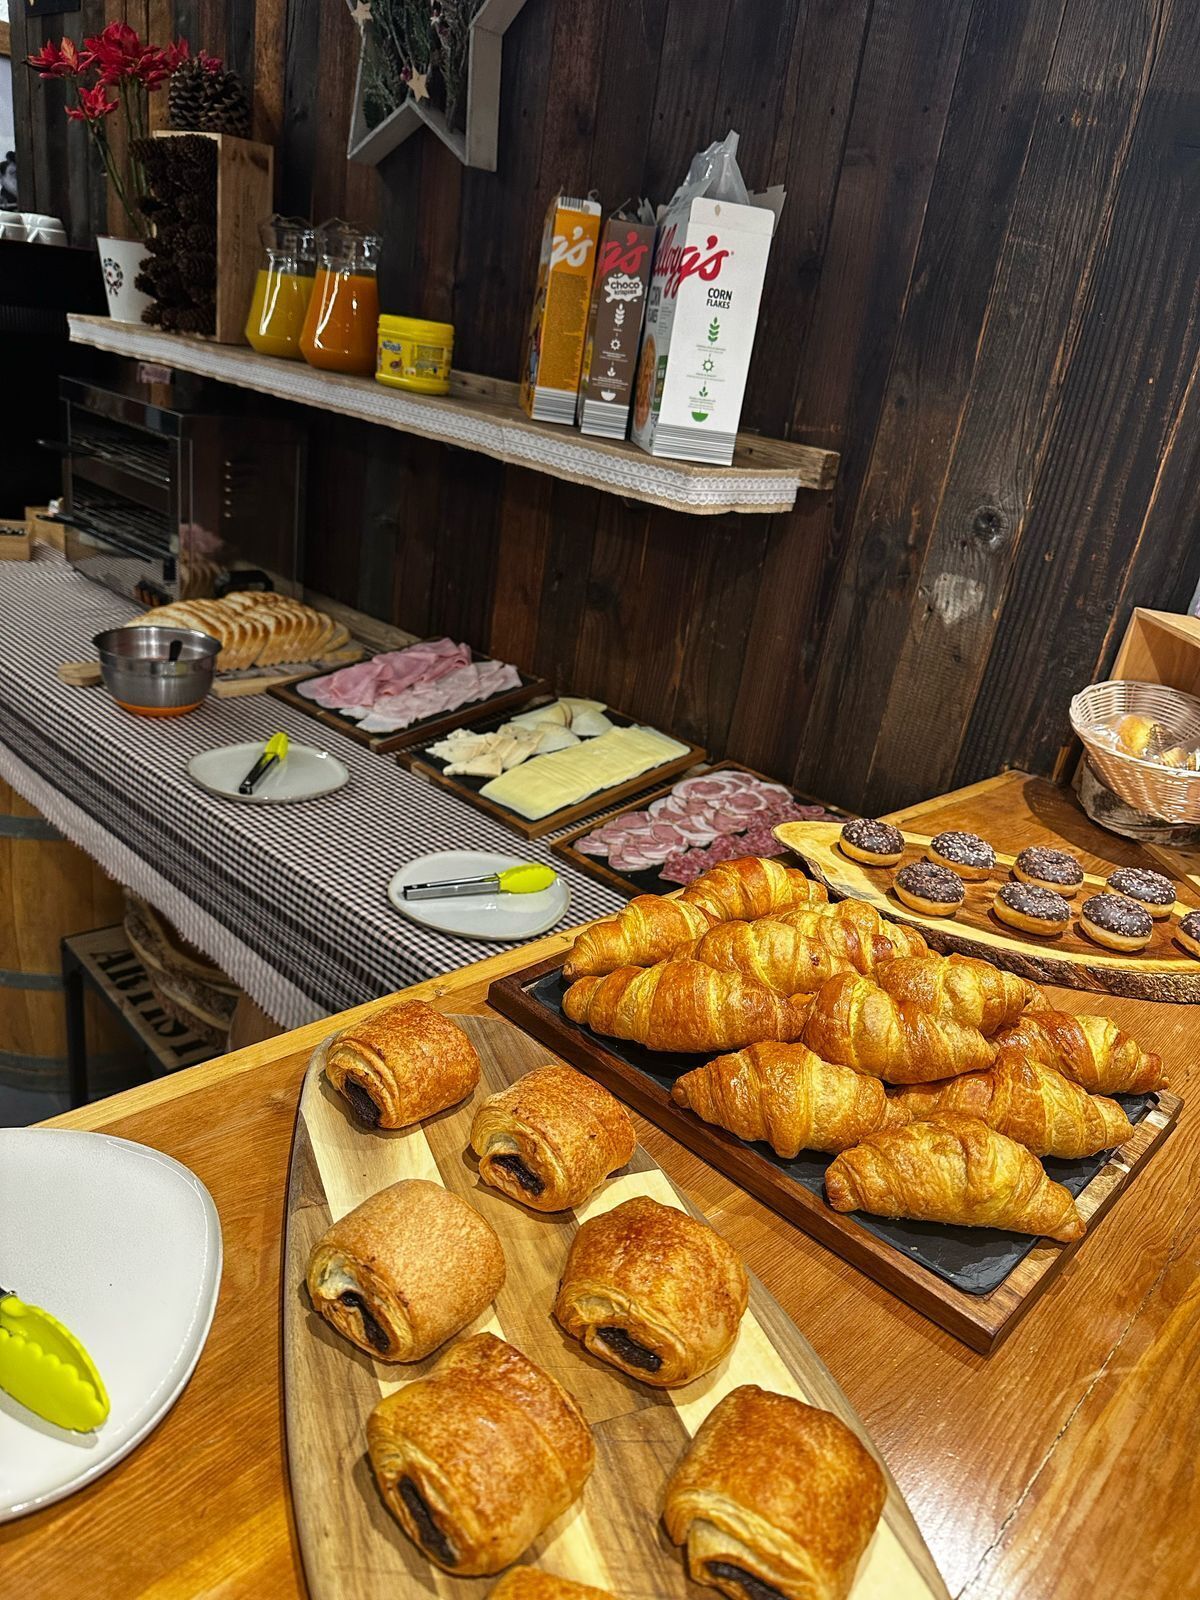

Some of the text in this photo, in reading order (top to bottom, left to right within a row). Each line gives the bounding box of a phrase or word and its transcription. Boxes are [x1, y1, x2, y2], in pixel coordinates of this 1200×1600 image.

[610, 279, 640, 290] choco
[708, 287, 733, 301] CORN
[706, 298, 730, 310] FLAKES
